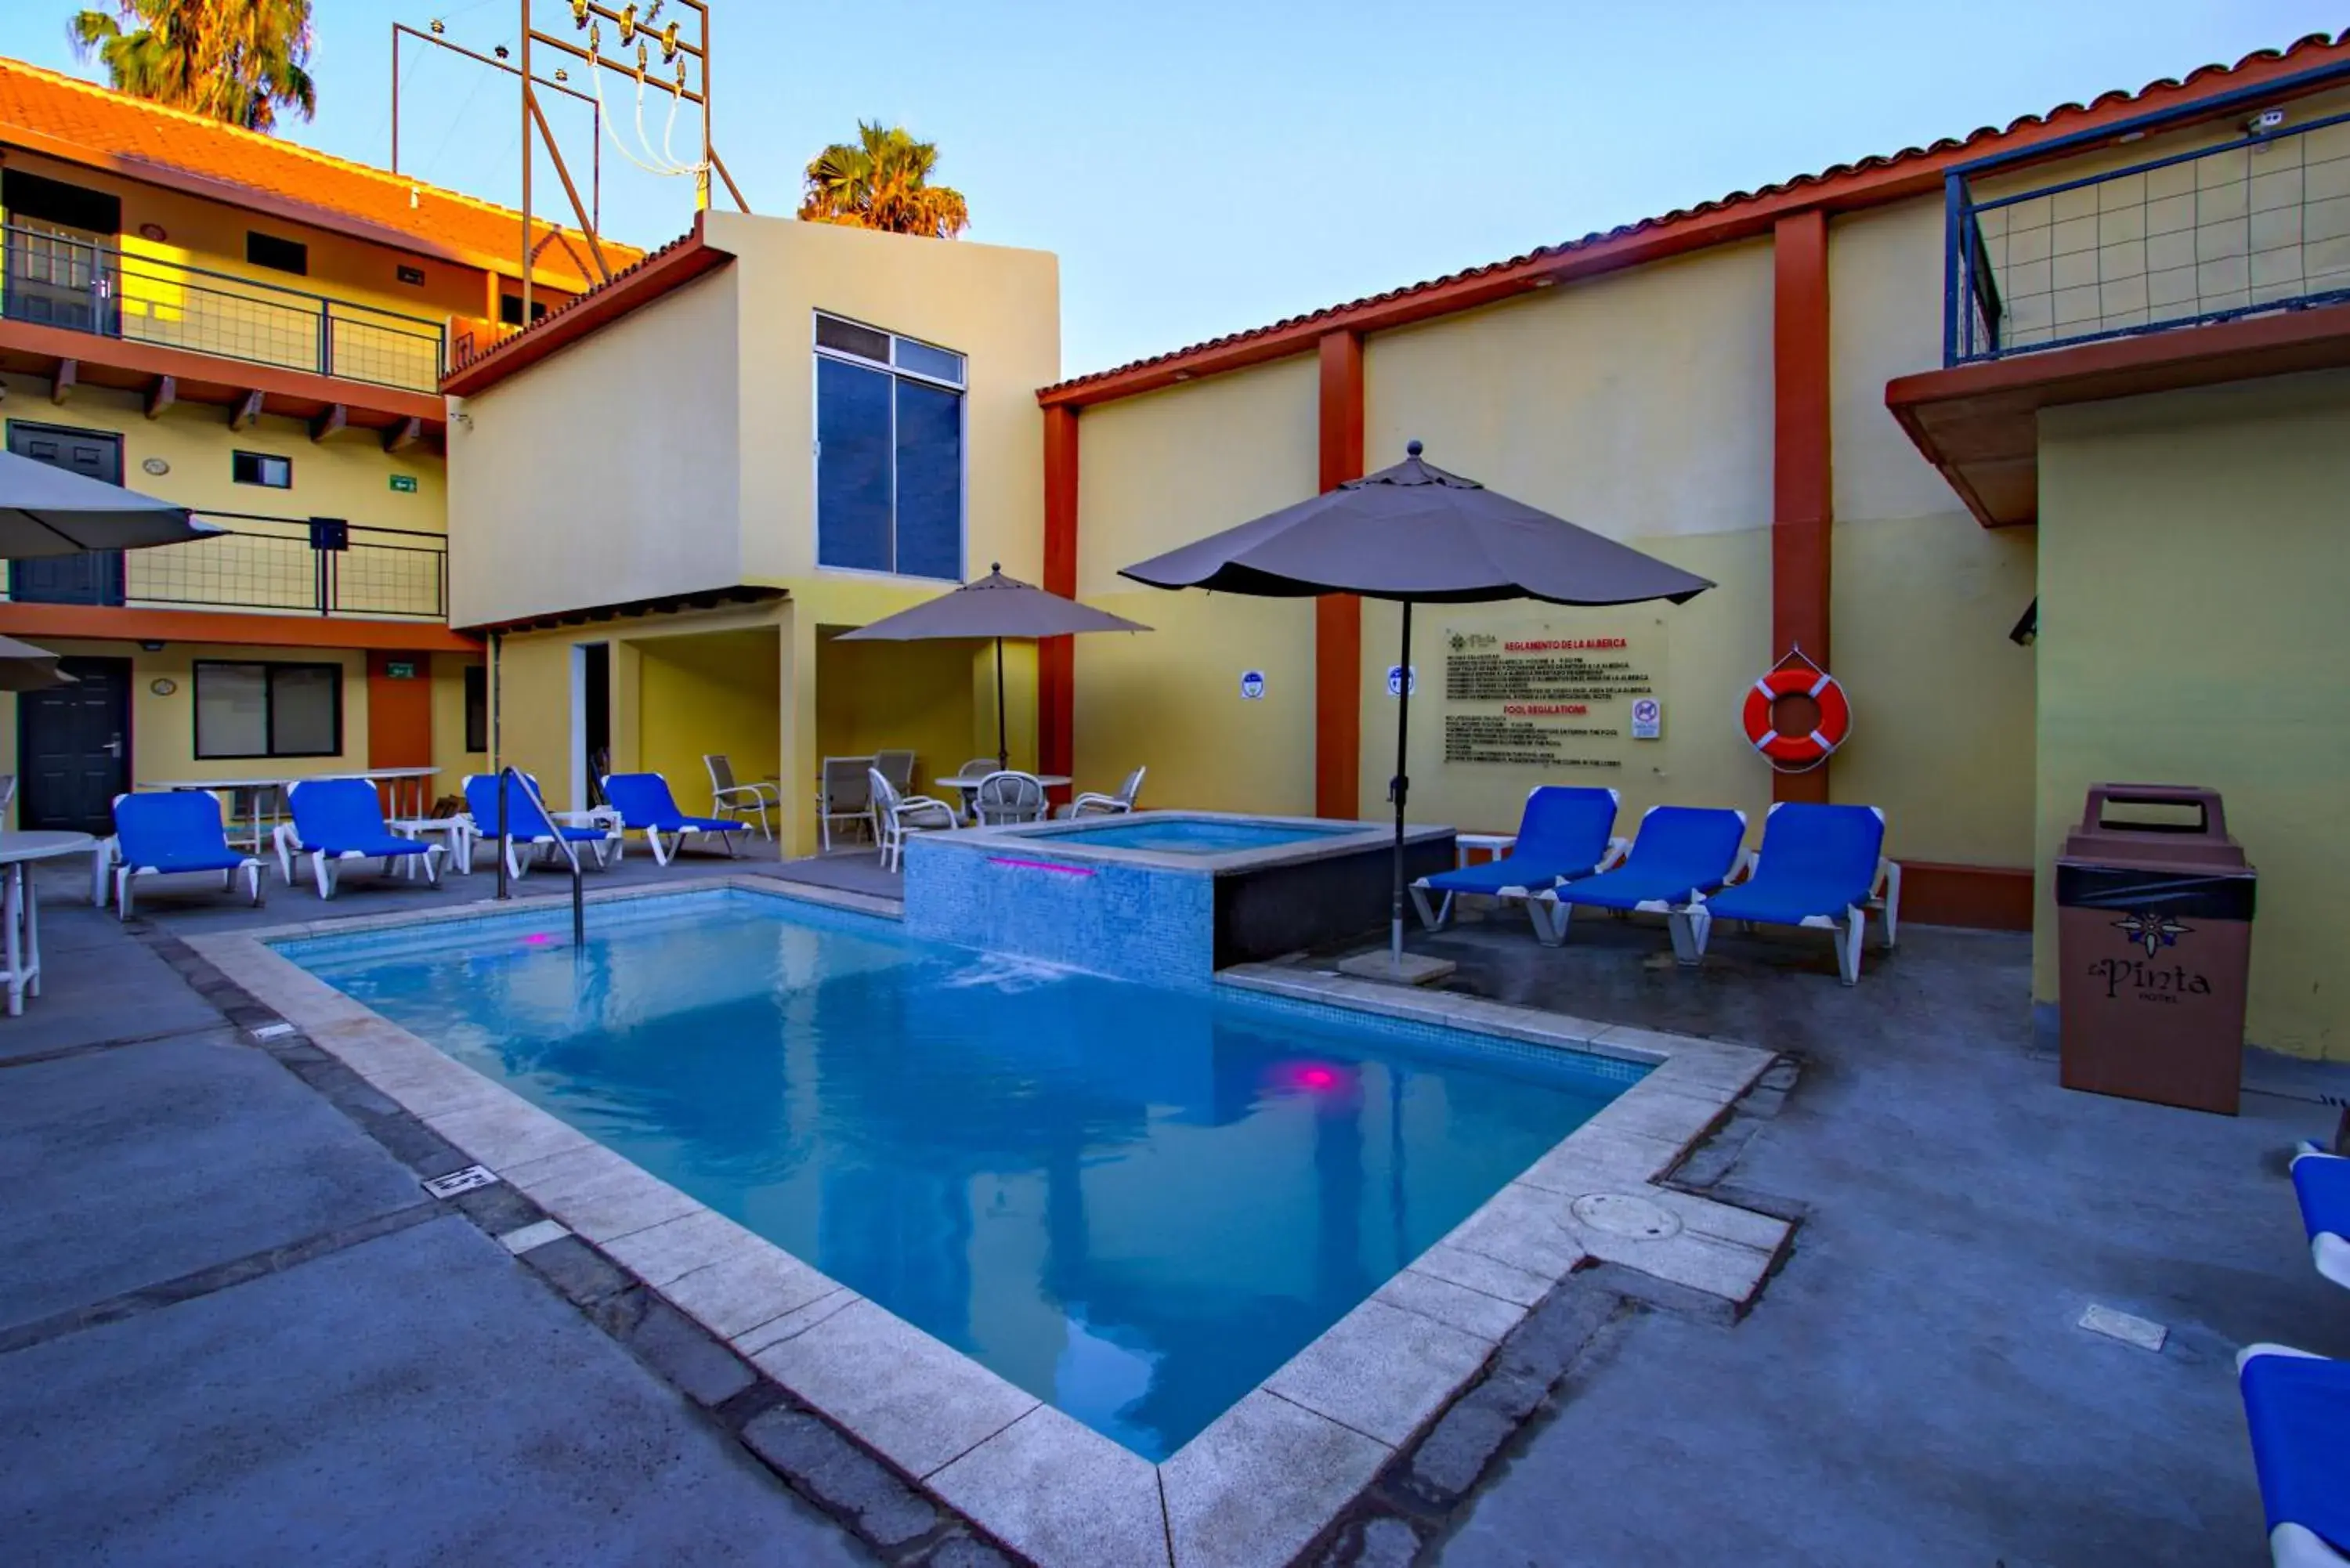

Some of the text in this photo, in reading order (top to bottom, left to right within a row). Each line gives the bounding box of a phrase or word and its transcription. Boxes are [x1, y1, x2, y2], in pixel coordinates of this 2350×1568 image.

[1504, 638, 1628, 652] REGLAMENTO DE LA ALBERCA
[1503, 704, 1587, 715] POOL REGULATIONS
[2101, 957, 2211, 998] Pinta
[2138, 992, 2179, 1004] HOTEL
